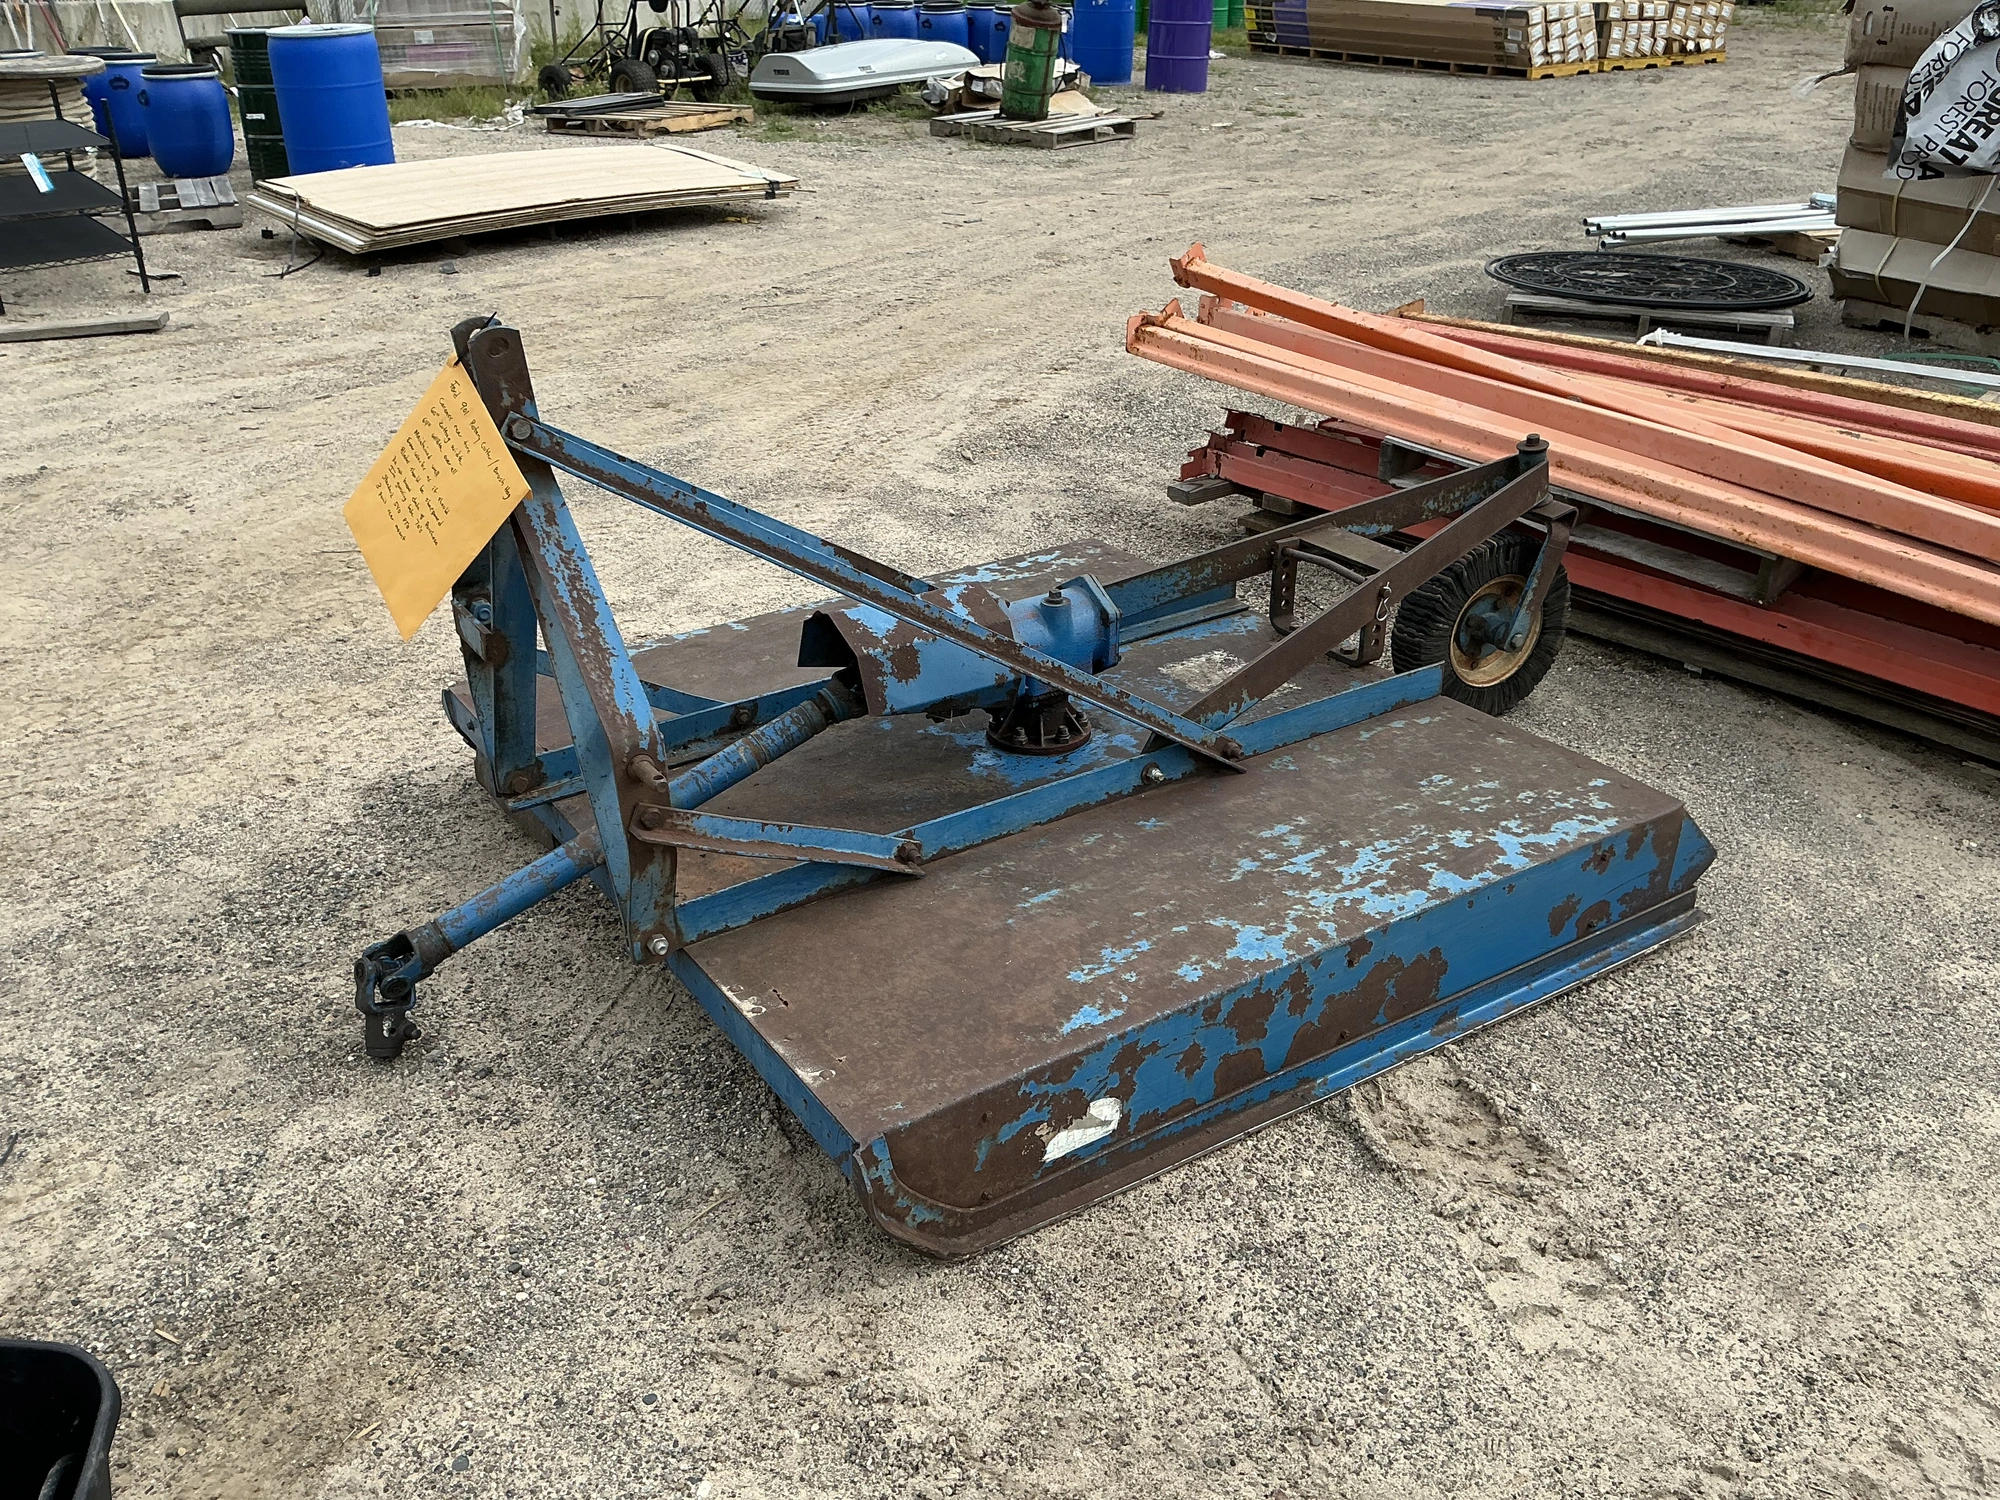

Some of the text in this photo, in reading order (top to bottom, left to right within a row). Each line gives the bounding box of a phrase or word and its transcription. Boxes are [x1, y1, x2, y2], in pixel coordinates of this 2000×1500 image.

[1934, 70, 1997, 138] FOREST
[450, 380, 461, 399] Ford
[460, 401, 470, 416] 901
[469, 419, 481, 444] Rotary
